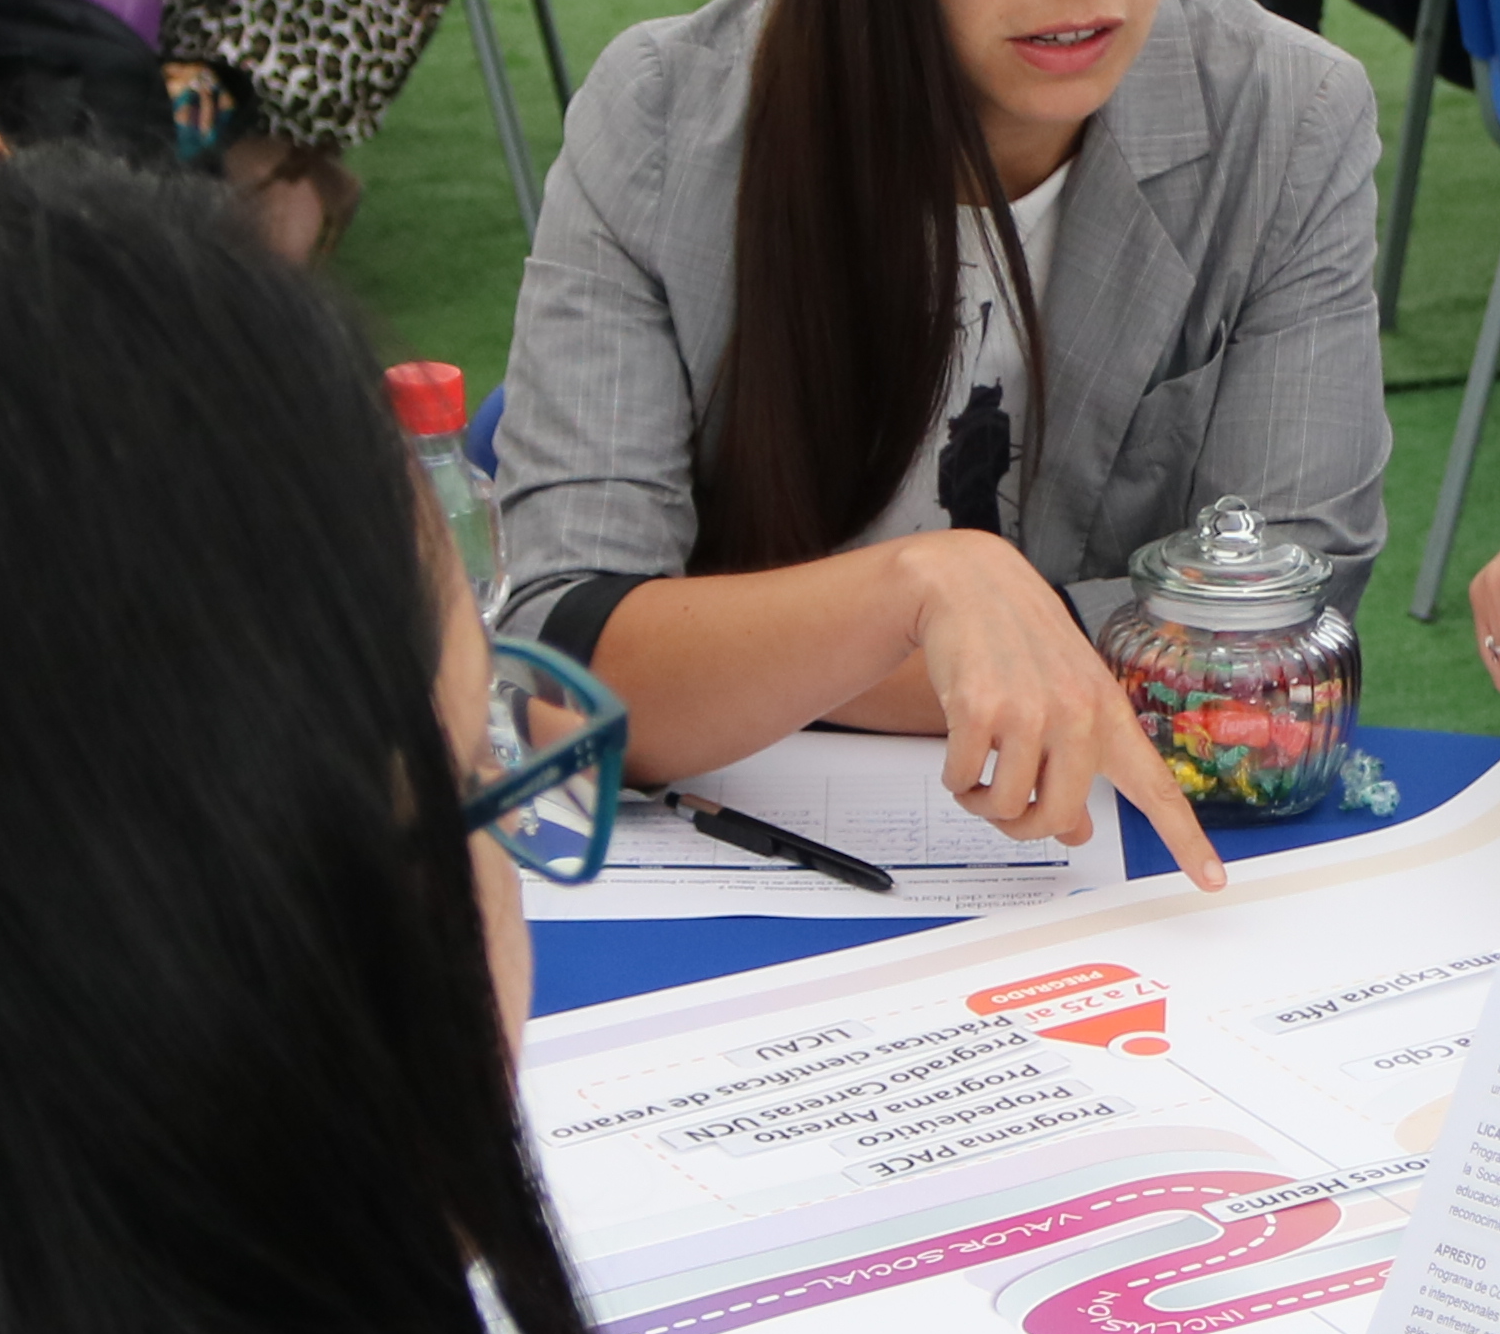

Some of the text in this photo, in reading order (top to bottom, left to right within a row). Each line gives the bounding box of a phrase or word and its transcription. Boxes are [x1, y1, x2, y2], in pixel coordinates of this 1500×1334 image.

[991, 970, 1103, 1004] PREGRADO
[1059, 978, 1171, 1014] 17 a 25
[1341, 967, 1451, 1003] Explora
[1277, 999, 1339, 1023] Afta
[756, 1028, 851, 1061] LICAU
[875, 1014, 1013, 1055] Prácticas
[716, 1050, 871, 1096] científicas
[1373, 1044, 1455, 1071] Cqbo
[668, 1091, 711, 1108] de
[685, 1032, 1028, 1142] Pregrado Carreras UCN
[753, 1063, 1041, 1143] Programa Apresto
[551, 1104, 665, 1139] verano
[858, 1085, 1073, 1147] Propedéutico
[868, 1102, 1115, 1178] Programa PACE
[1226, 1178, 1346, 1214] Heuma
[803, 1211, 1083, 1291] VALOR SOCIAL
[1434, 1242, 1486, 1268] APRESTO
[1426, 1262, 1473, 1289] Programa
[1473, 1280, 1488, 1294] de
